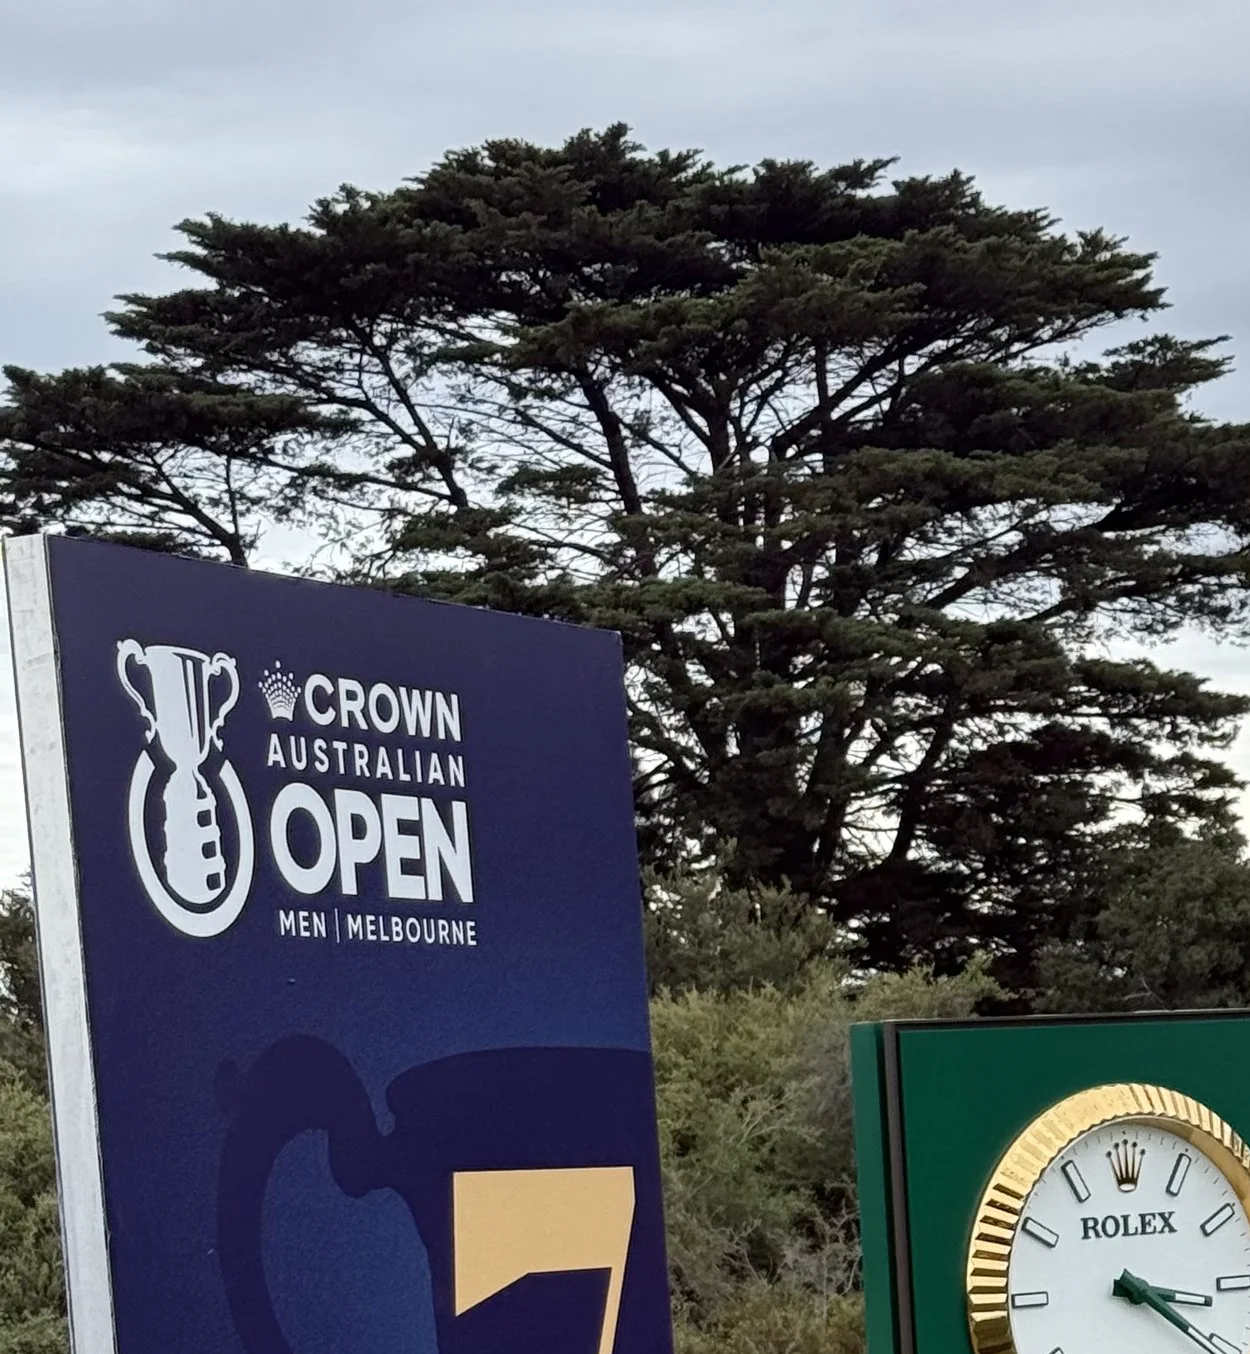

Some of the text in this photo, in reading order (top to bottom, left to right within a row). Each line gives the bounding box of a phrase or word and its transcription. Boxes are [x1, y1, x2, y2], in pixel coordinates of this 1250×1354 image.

[304, 674, 462, 742] CROWN
[267, 733, 466, 788] AUSTRALIAN
[270, 782, 474, 903] OPEN
[279, 909, 478, 946] MEN MELBOURNE
[1080, 1210, 1179, 1241] ROLEX
